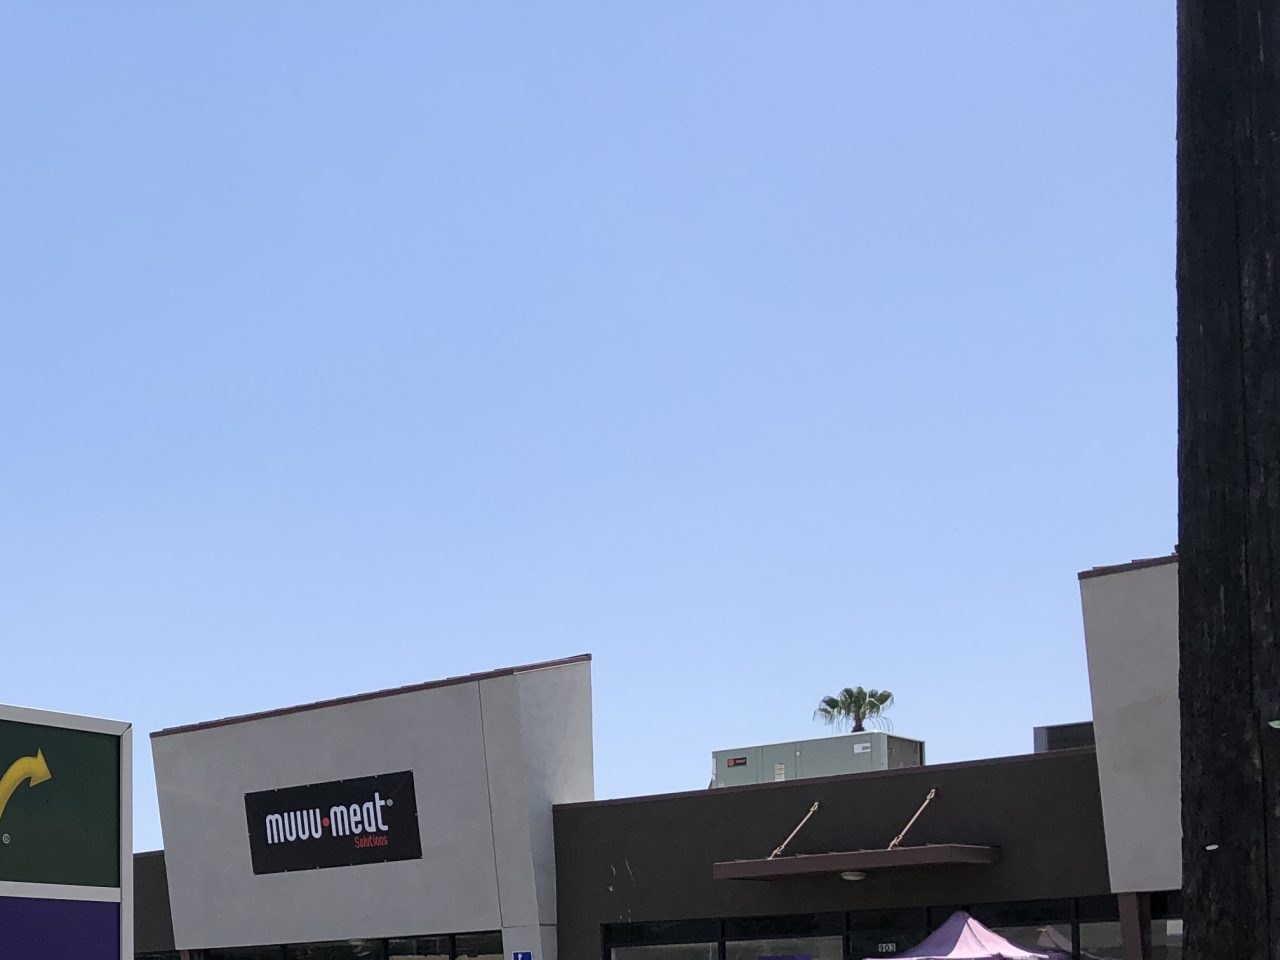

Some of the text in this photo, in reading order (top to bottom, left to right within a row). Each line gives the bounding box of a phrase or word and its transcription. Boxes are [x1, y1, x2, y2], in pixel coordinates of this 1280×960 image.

[266, 792, 389, 844] muuu meat
[354, 835, 388, 849] Solutions
[879, 943, 896, 952] 903
